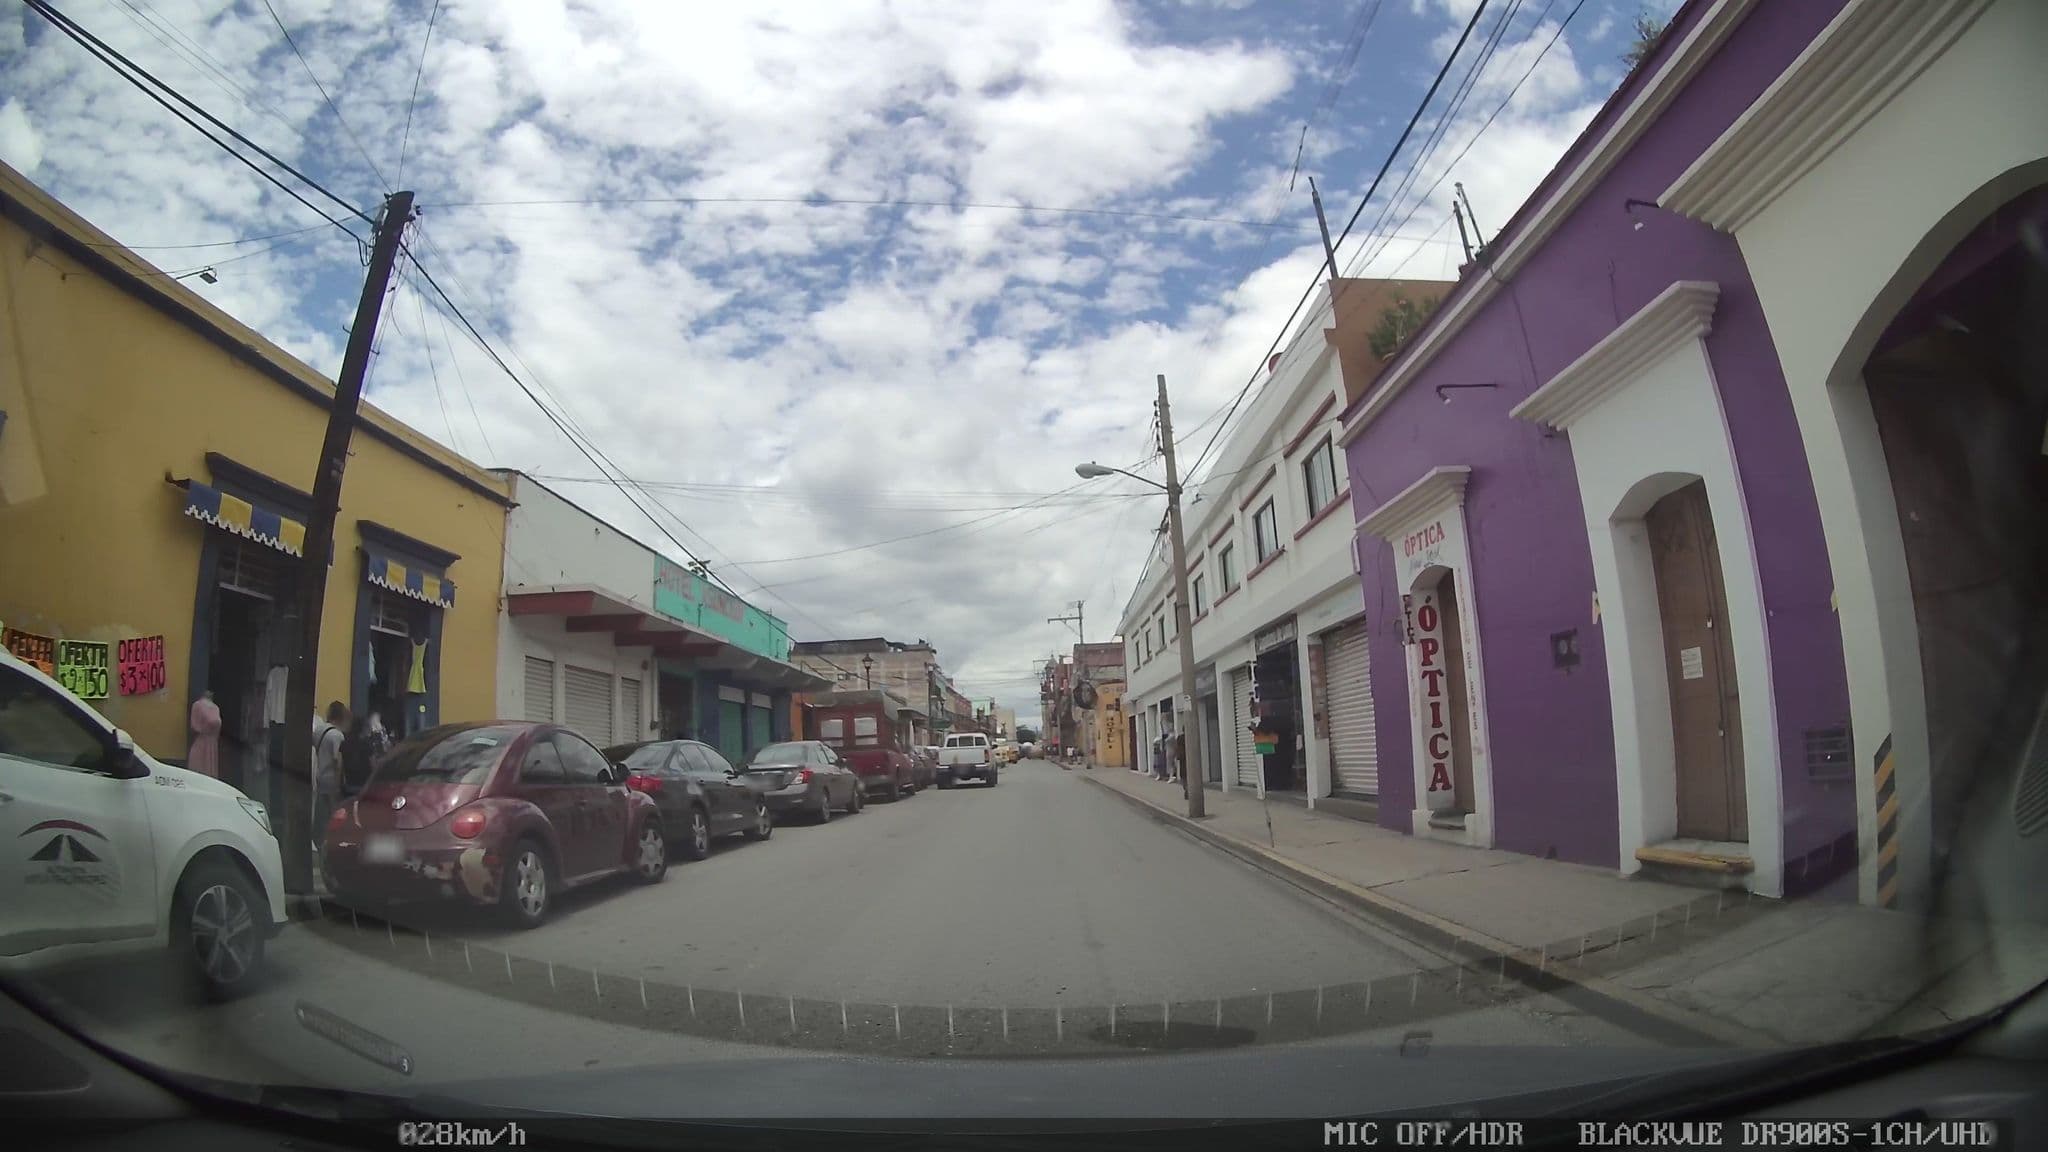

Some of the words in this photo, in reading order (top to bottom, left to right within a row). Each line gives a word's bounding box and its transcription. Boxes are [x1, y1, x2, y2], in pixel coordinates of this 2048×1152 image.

[1404, 521, 1445, 558] ÓPTICA
[59, 640, 108, 667] OFERTA
[118, 635, 164, 663] OFERTA
[1417, 595, 1452, 792] ÓPTICA
